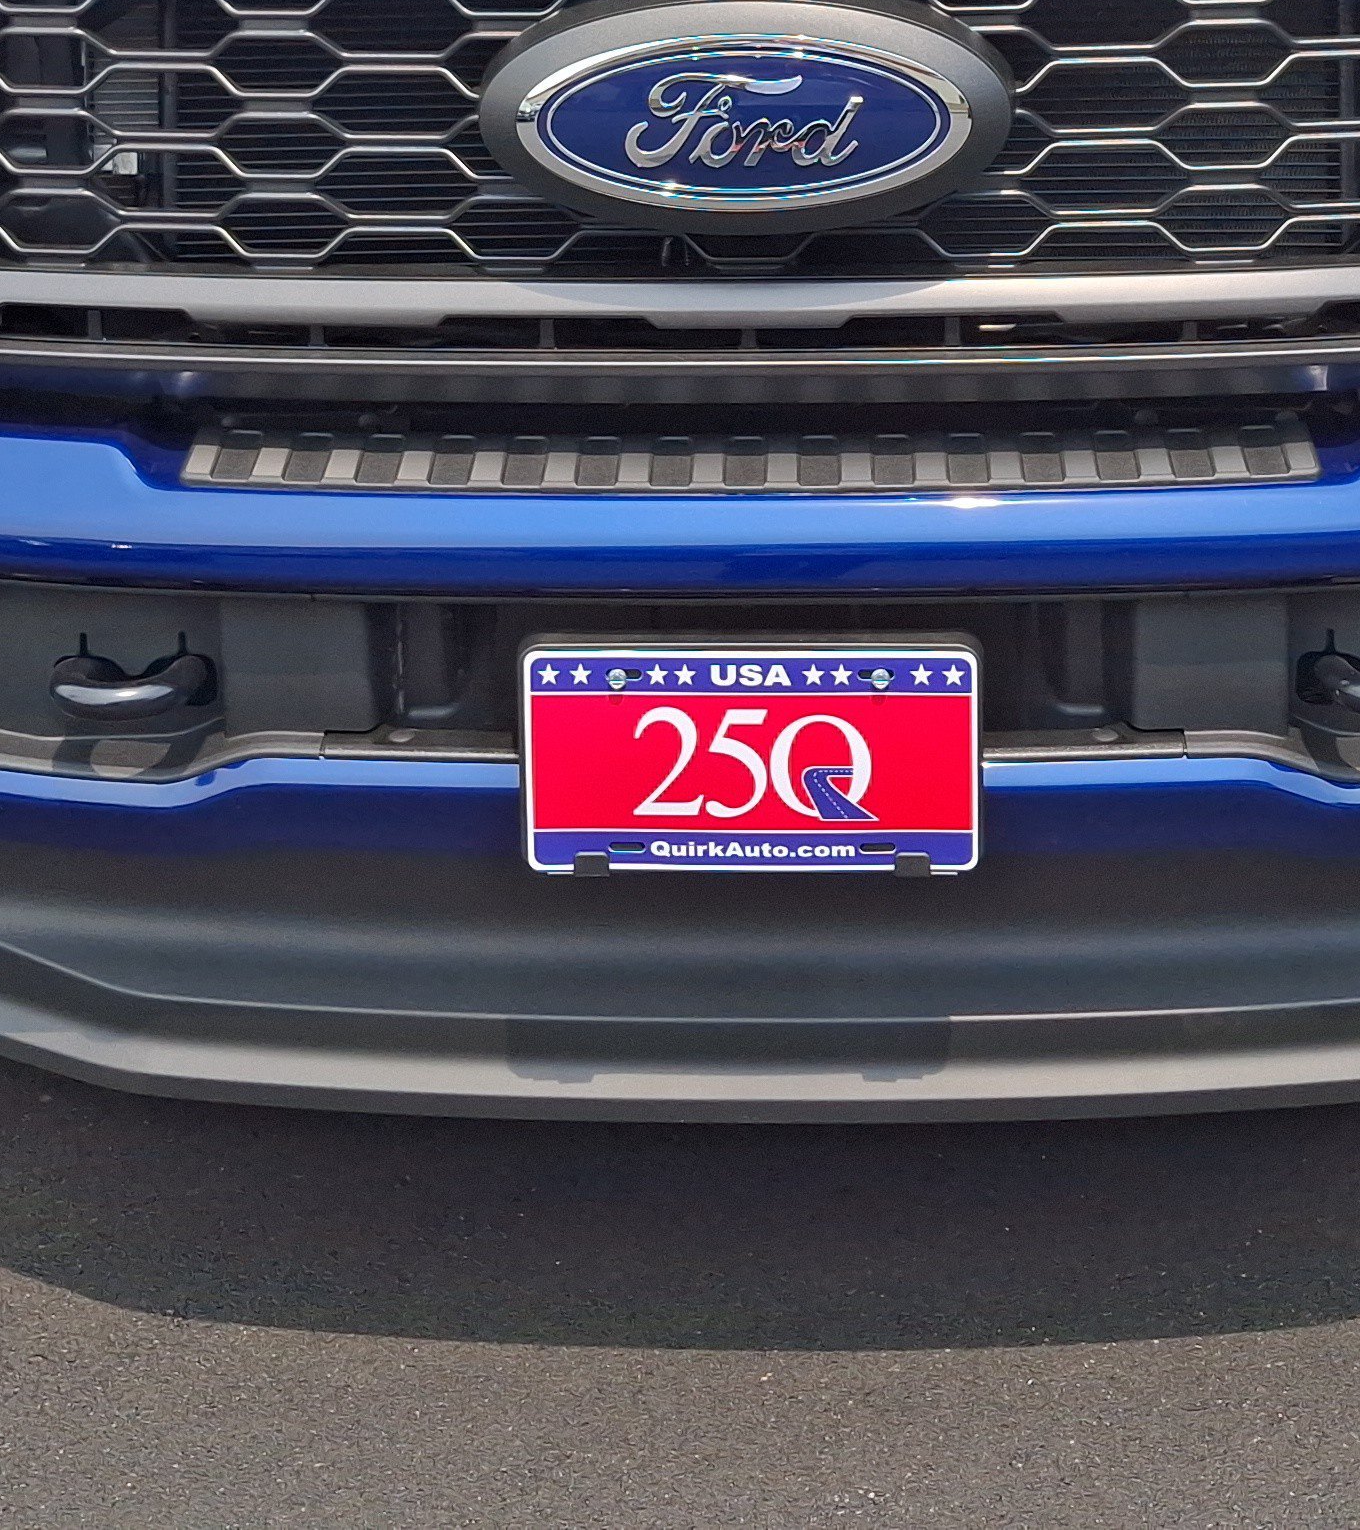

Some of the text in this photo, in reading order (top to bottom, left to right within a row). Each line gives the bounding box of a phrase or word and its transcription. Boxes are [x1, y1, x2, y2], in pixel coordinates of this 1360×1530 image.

[625, 72, 865, 169] Ford
[710, 664, 792, 687] USA
[650, 840, 856, 858] QuirkAuto.com
